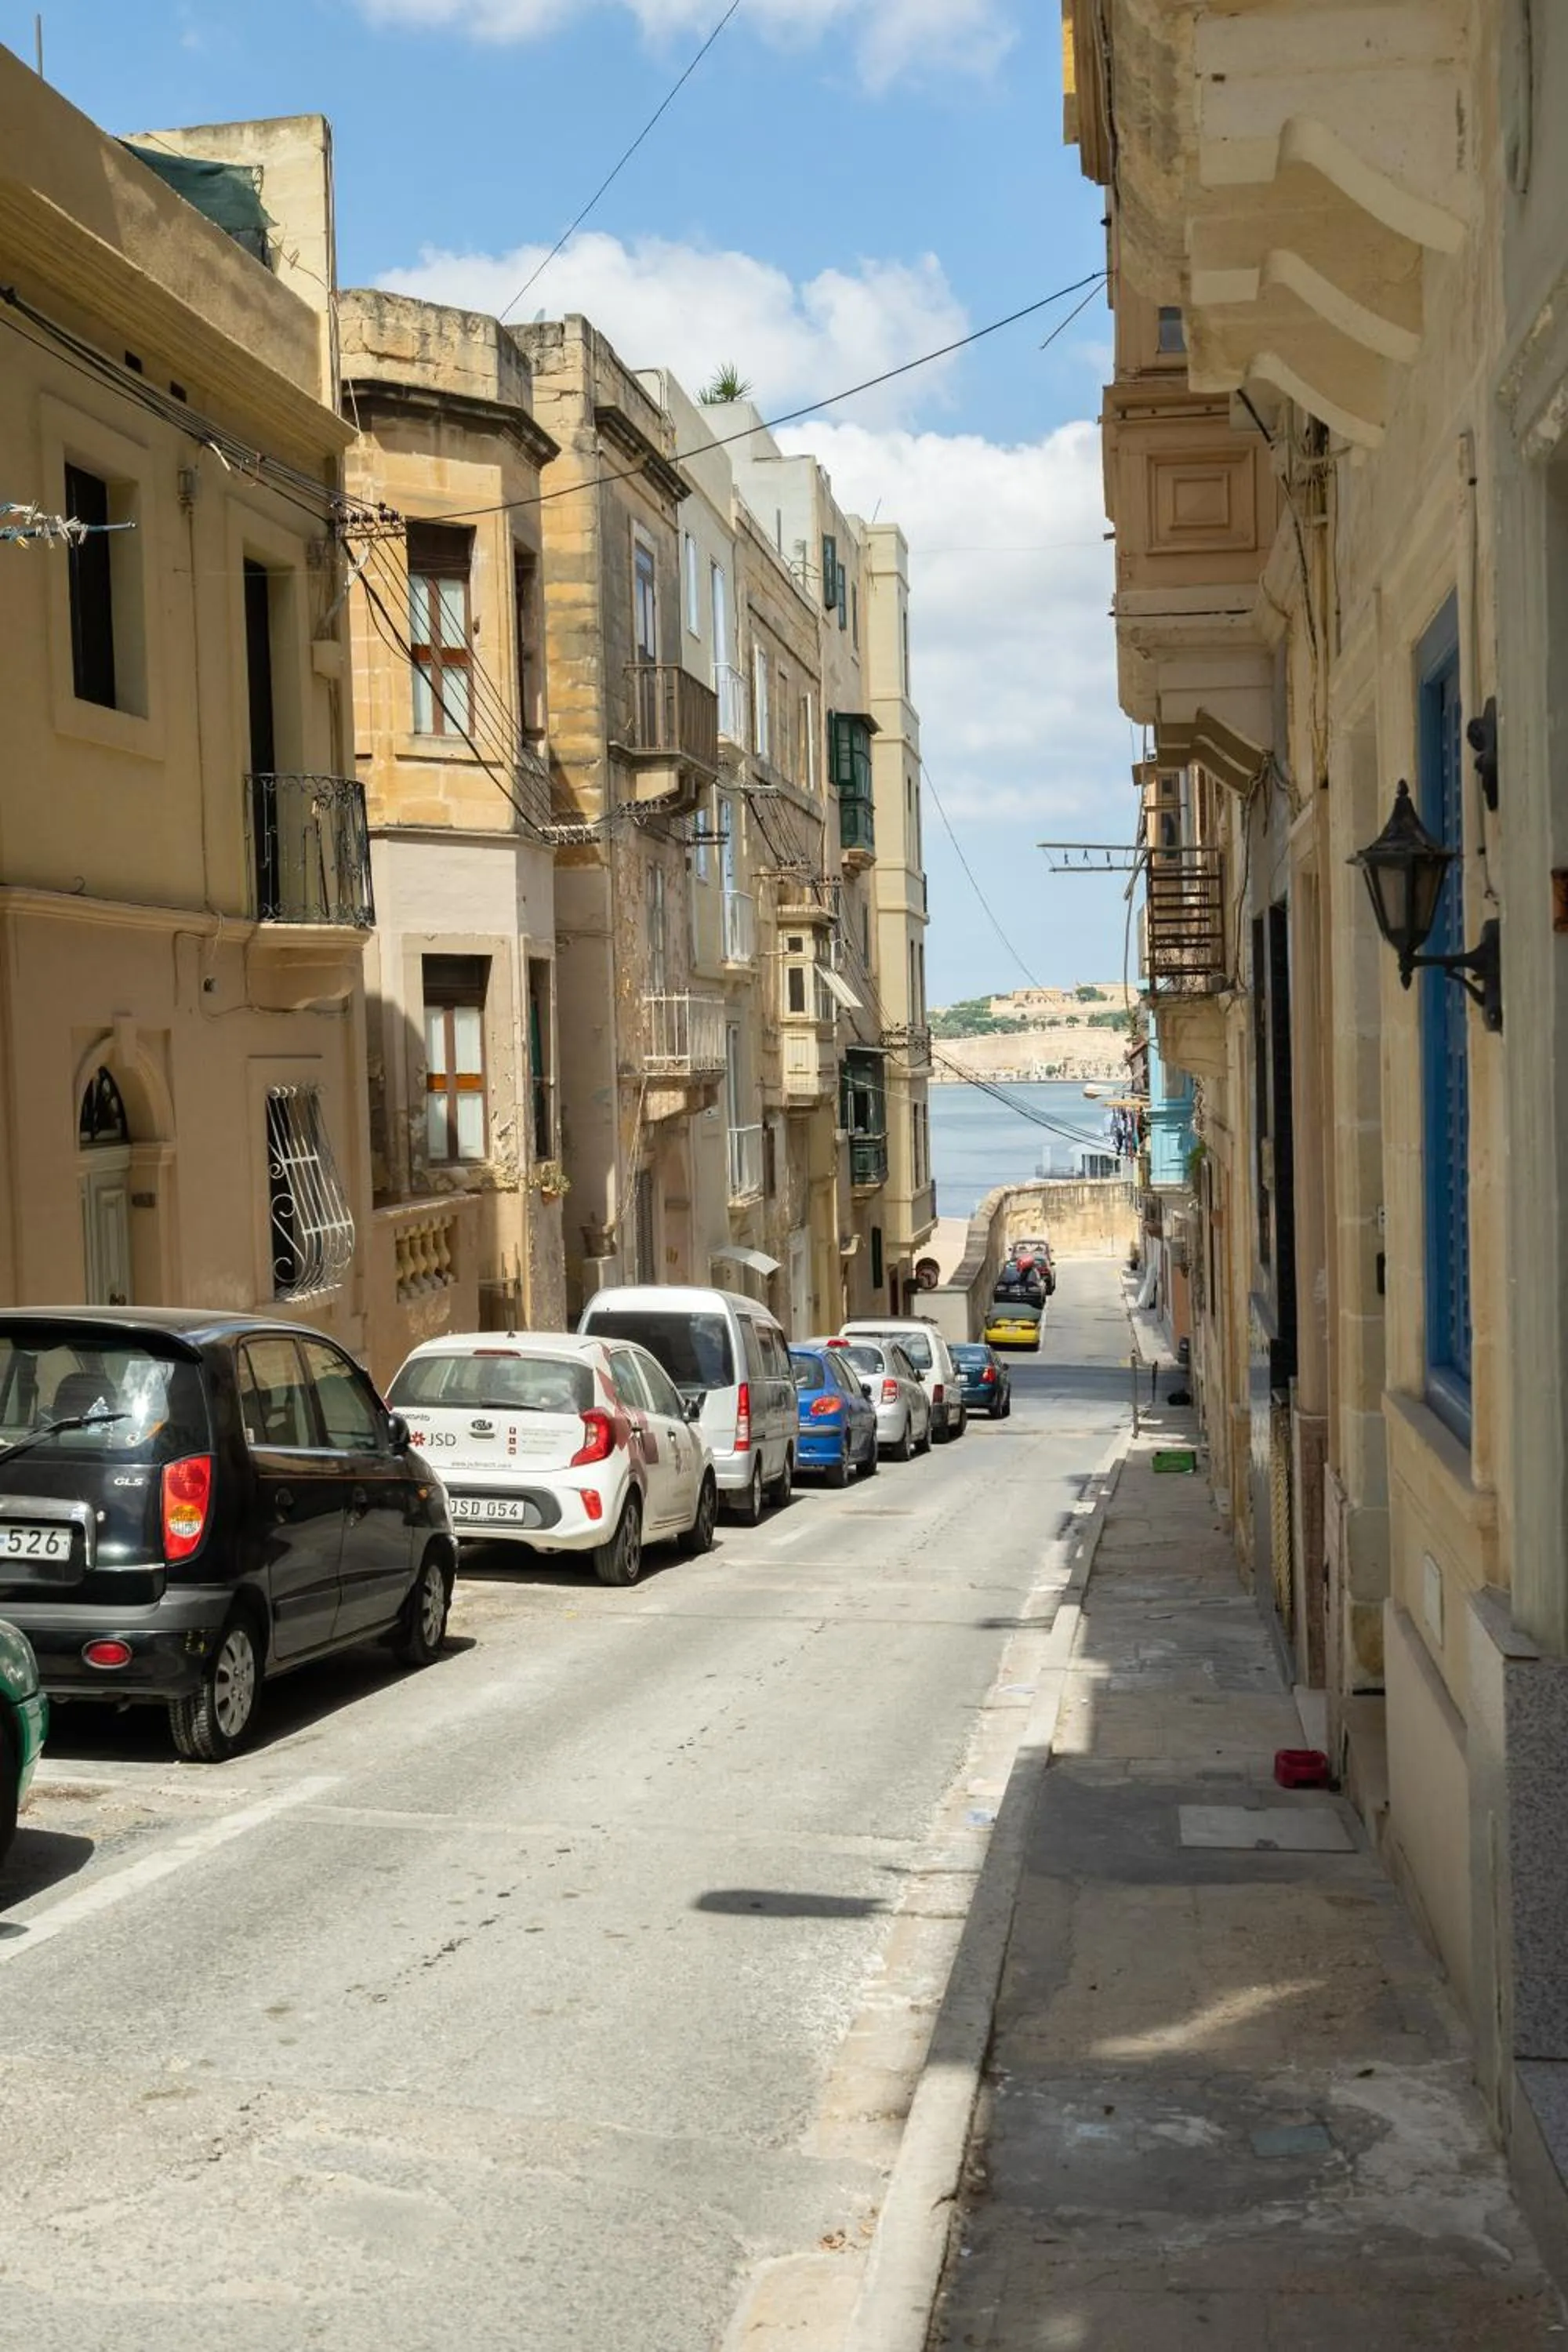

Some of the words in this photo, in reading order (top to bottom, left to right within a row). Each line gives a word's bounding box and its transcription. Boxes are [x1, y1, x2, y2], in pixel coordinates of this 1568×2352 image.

[428, 1432, 456, 1446] JSD
[114, 1477, 144, 1486] GLS
[451, 1500, 481, 1515] JSD
[487, 1501, 518, 1518] 054
[7, 1529, 60, 1555] 526
